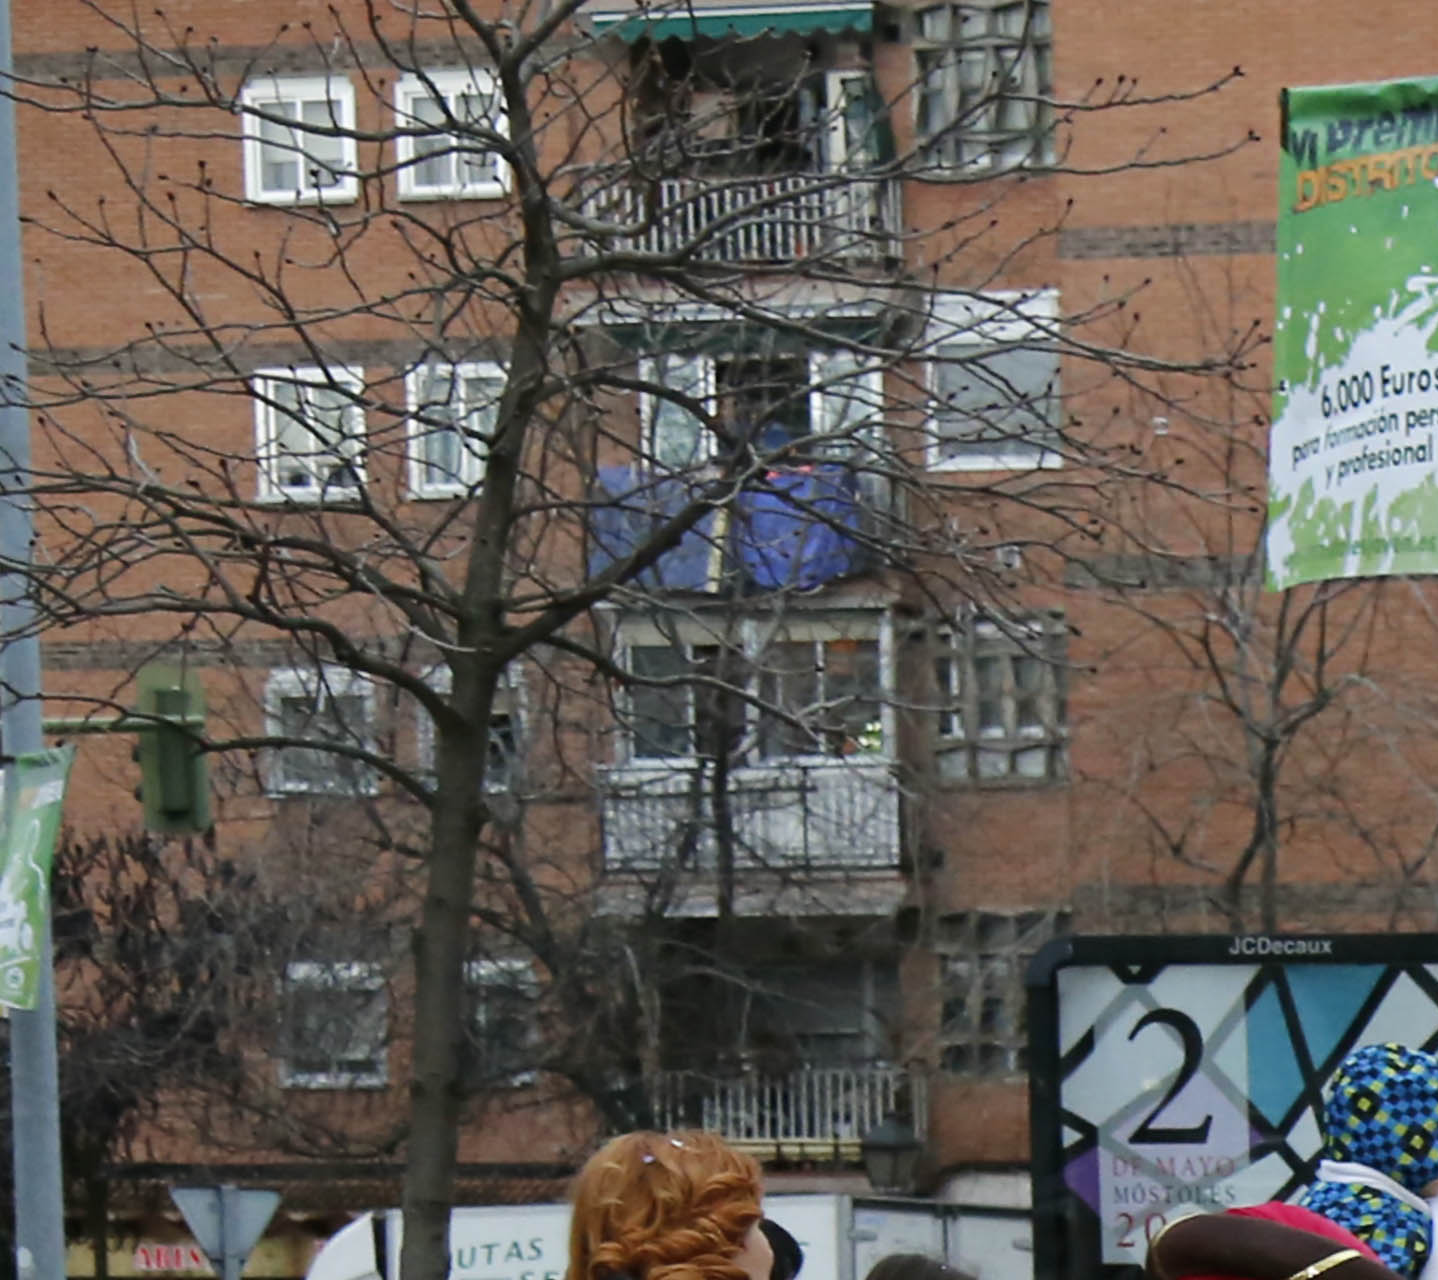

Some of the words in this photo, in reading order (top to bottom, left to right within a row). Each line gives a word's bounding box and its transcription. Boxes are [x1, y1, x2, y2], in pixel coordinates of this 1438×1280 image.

[1321, 371, 1374, 418] 6.000
[1291, 437, 1320, 472] para
[1324, 407, 1399, 450] formación
[1338, 435, 1433, 481] profesional
[1228, 936, 1333, 955] JCDecaux
[1127, 1008, 1214, 1145] 2
[1112, 1156, 1140, 1177] DE
[1156, 1156, 1235, 1177] MAYO
[456, 1236, 545, 1270] UTAS
